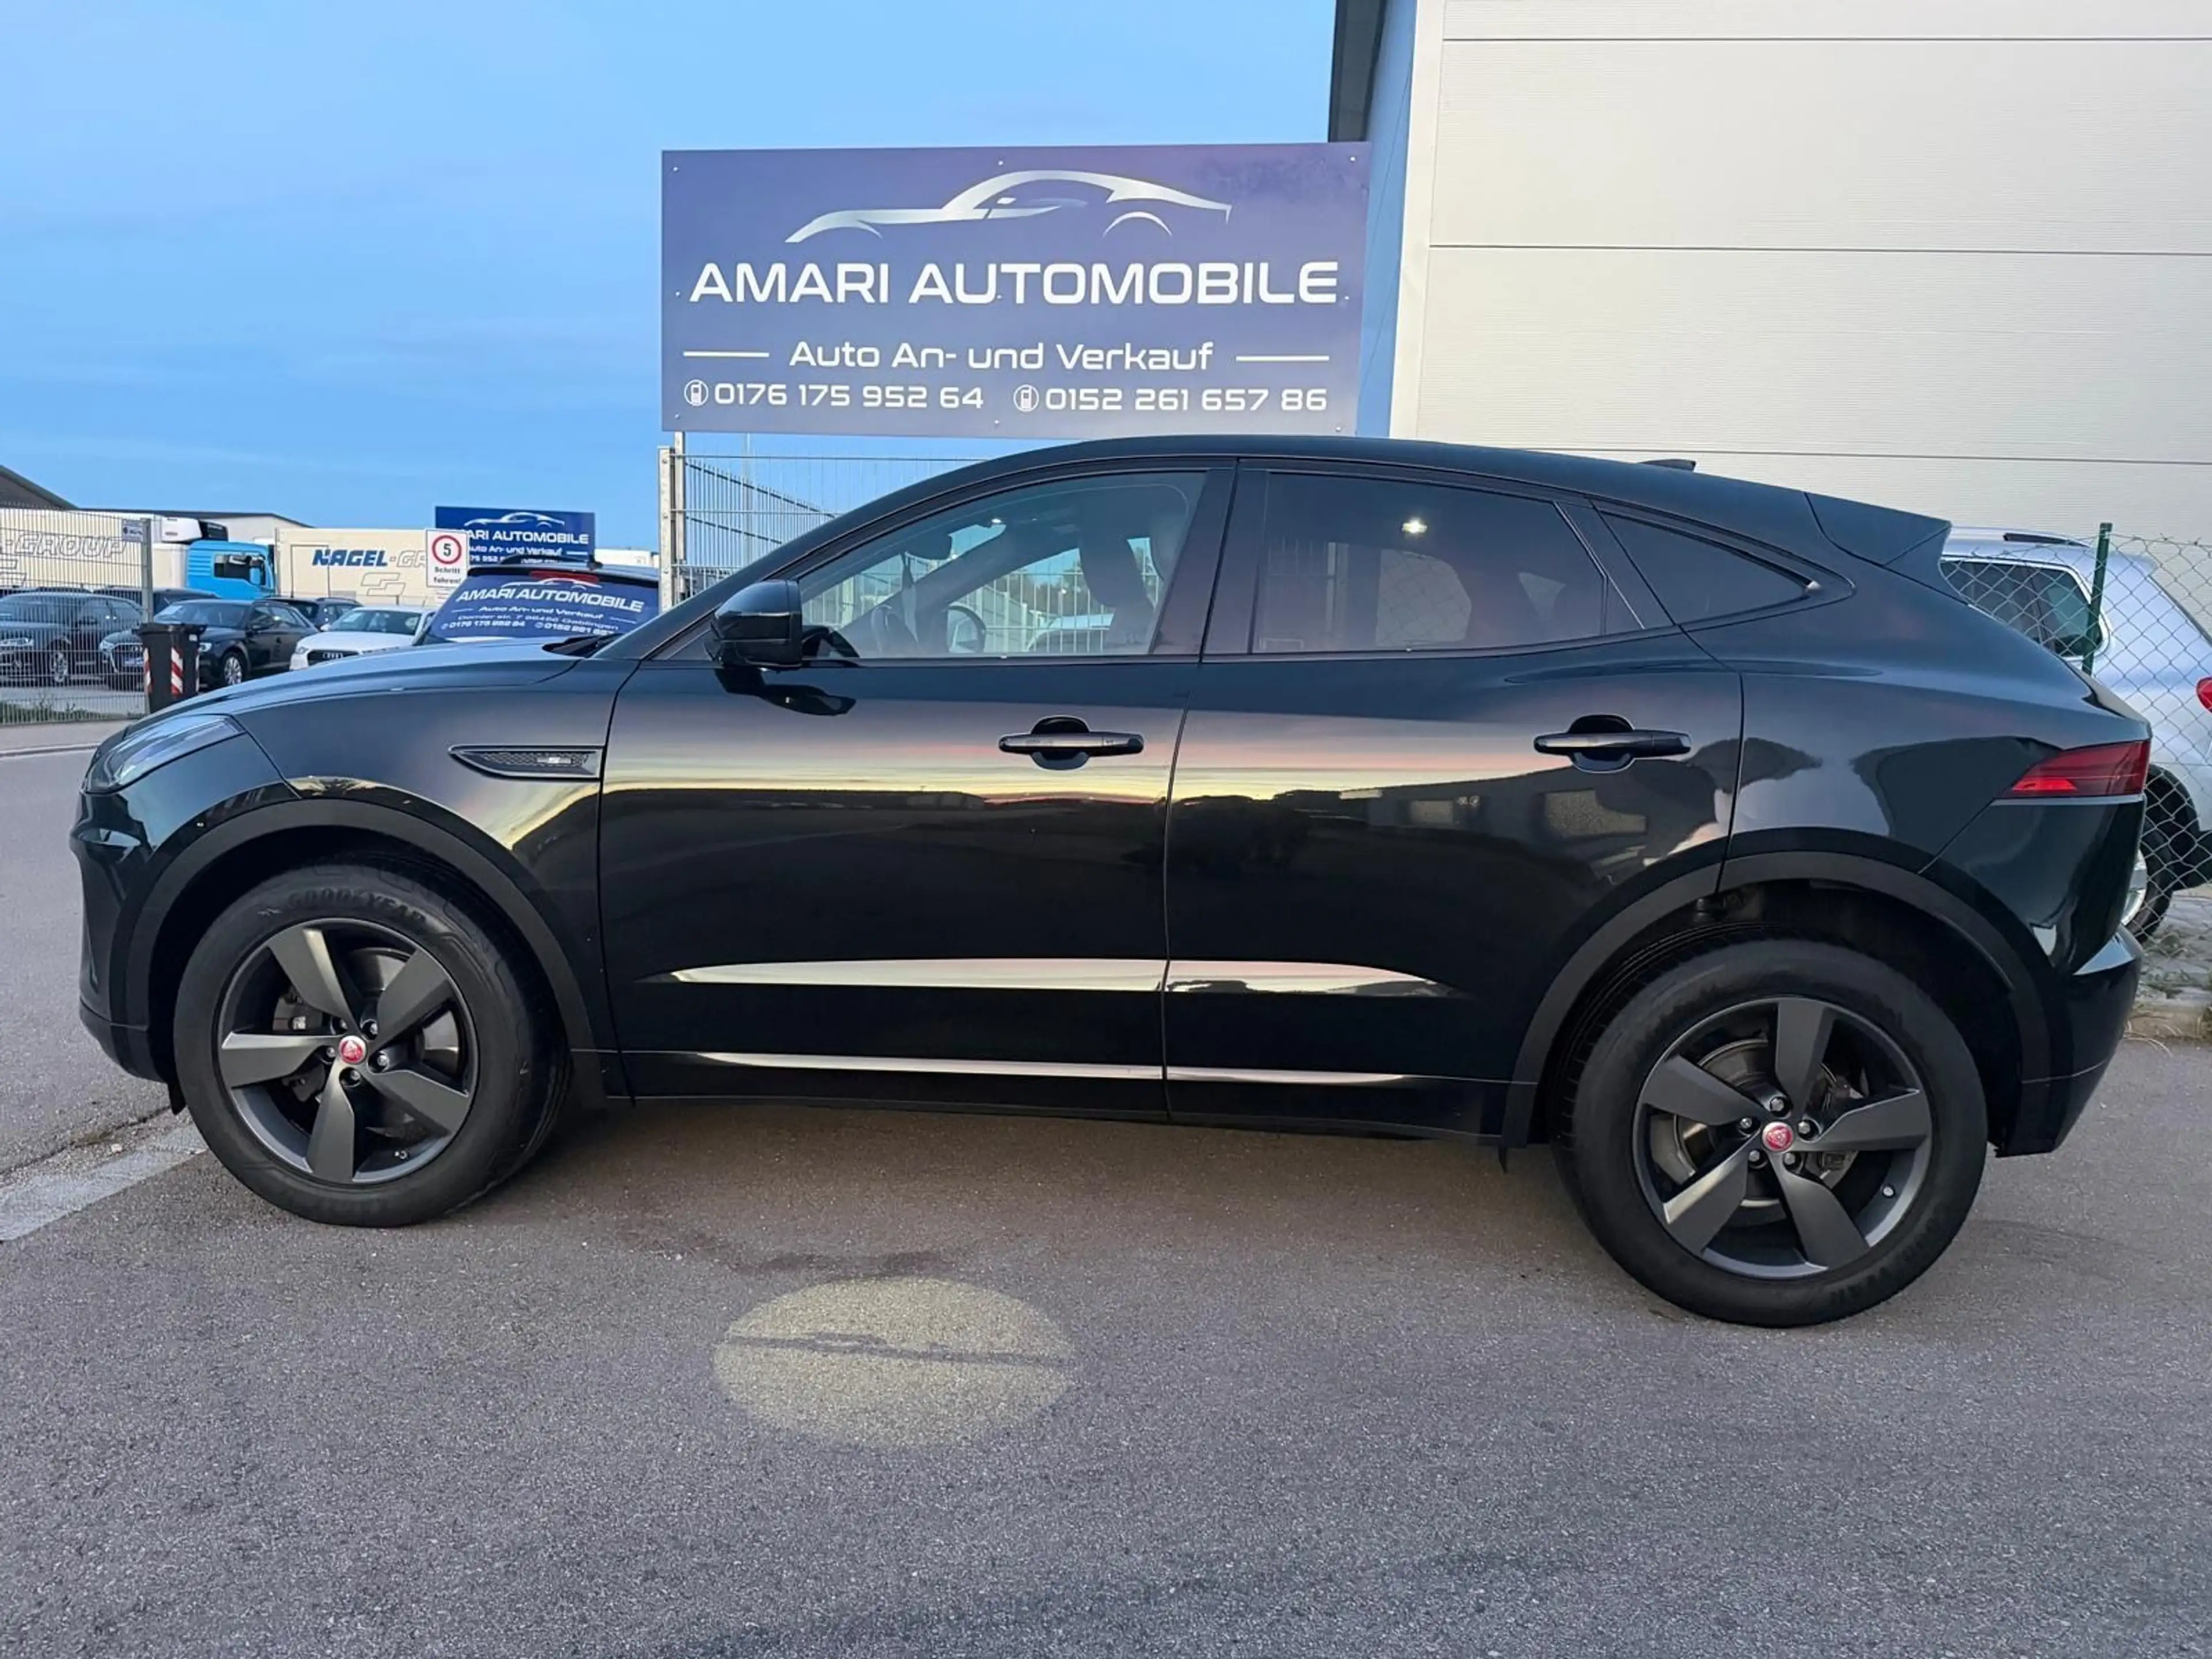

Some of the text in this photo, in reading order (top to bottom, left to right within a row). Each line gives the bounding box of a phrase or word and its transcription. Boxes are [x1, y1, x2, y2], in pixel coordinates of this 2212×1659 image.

[690, 262, 1339, 305] AMARI AUTOMOBILE
[789, 341, 1214, 370] Auto An- und Verkauf
[714, 382, 984, 410] 0176 175 952 64
[1045, 388, 1328, 412] 0152 261 657 86
[467, 529, 589, 544] ARI AUTOMOBILE
[312, 549, 426, 568] NAGEL-GR
[443, 543, 452, 557] 5
[506, 546, 525, 555] und
[526, 547, 563, 556] Verkauf
[434, 566, 460, 574] Schritt
[455, 588, 513, 603] AMARI
[517, 588, 644, 612] AUTOMOBILE
[556, 608, 604, 620] Verkauf
